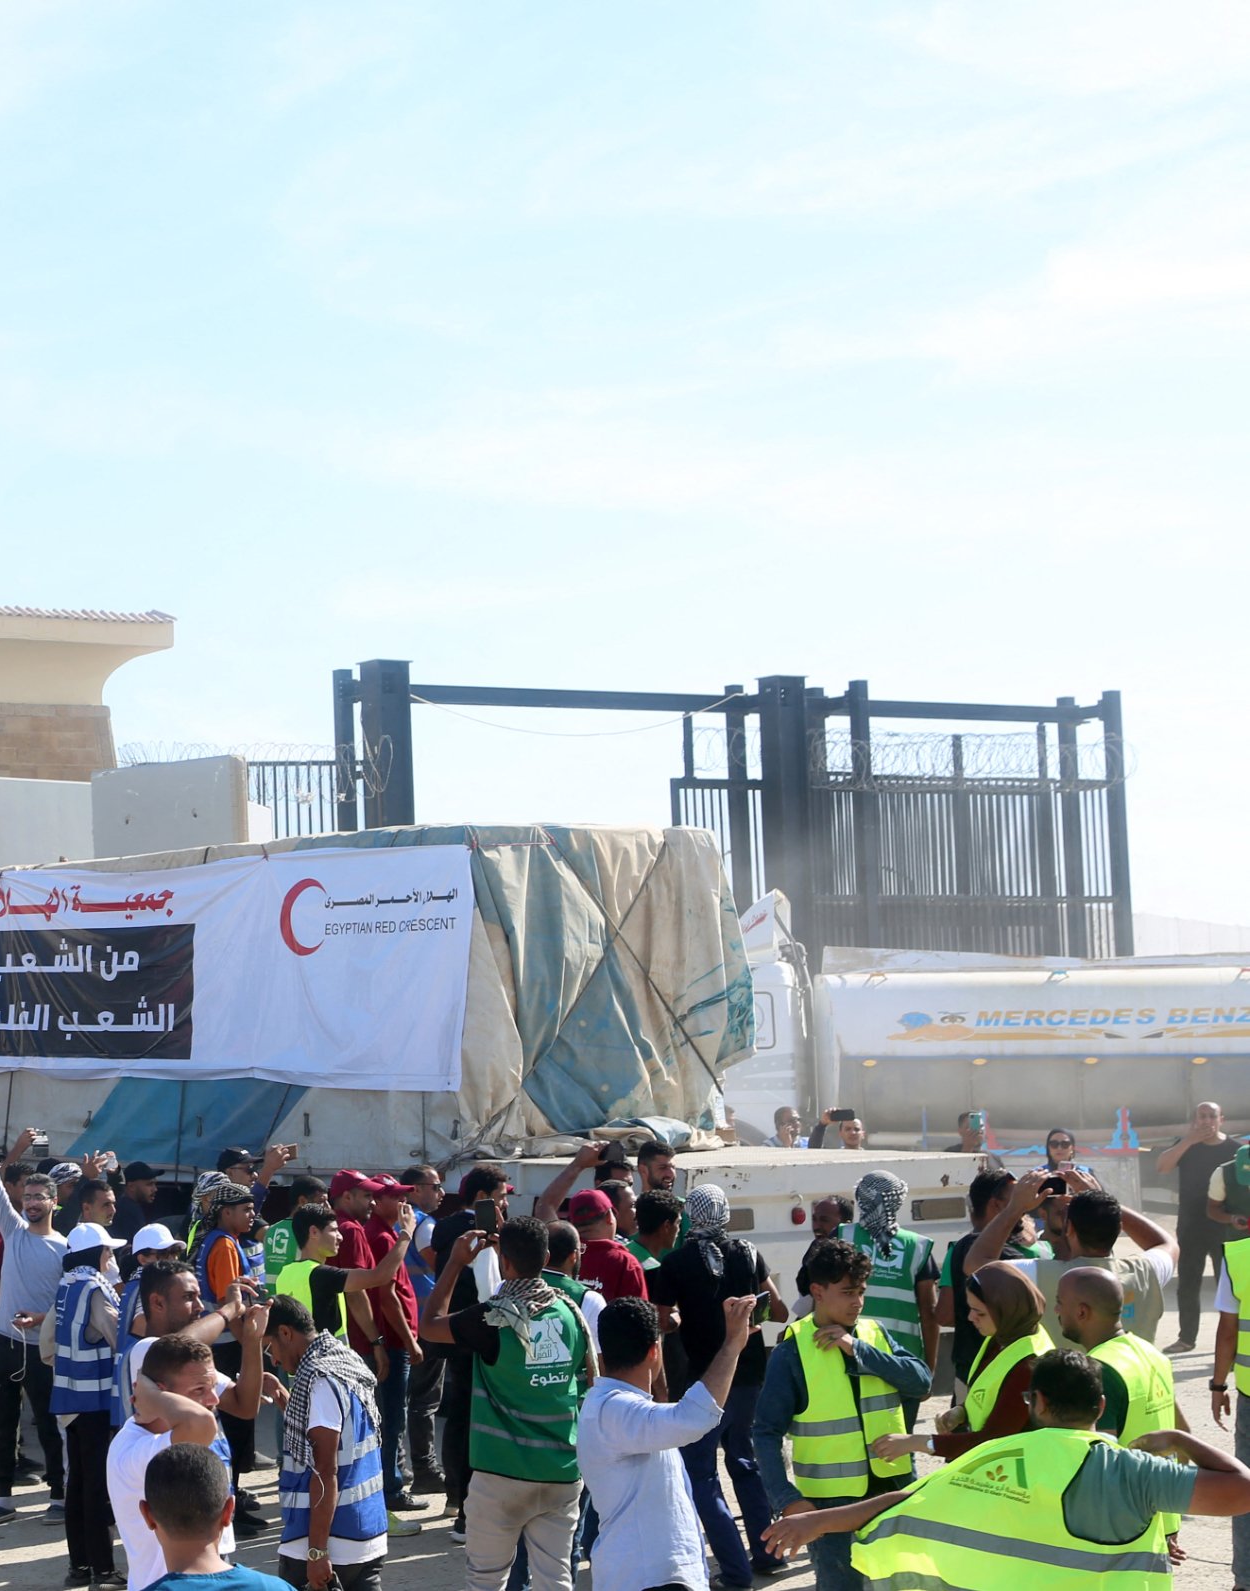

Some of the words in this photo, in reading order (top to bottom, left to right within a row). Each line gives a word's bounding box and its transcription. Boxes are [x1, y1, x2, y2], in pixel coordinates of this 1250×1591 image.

[70, 884, 174, 920] جمعية
[375, 888, 422, 907] الأحمر
[422, 888, 458, 905] الهلال
[324, 921, 373, 936] EGYPTIAN
[375, 920, 397, 934] RED
[398, 917, 457, 933] CRESCENT
[99, 945, 140, 981] من
[57, 996, 175, 1040] الشعب
[975, 1008, 1156, 1027] MERCEDES
[530, 1372, 569, 1387] متطوع
